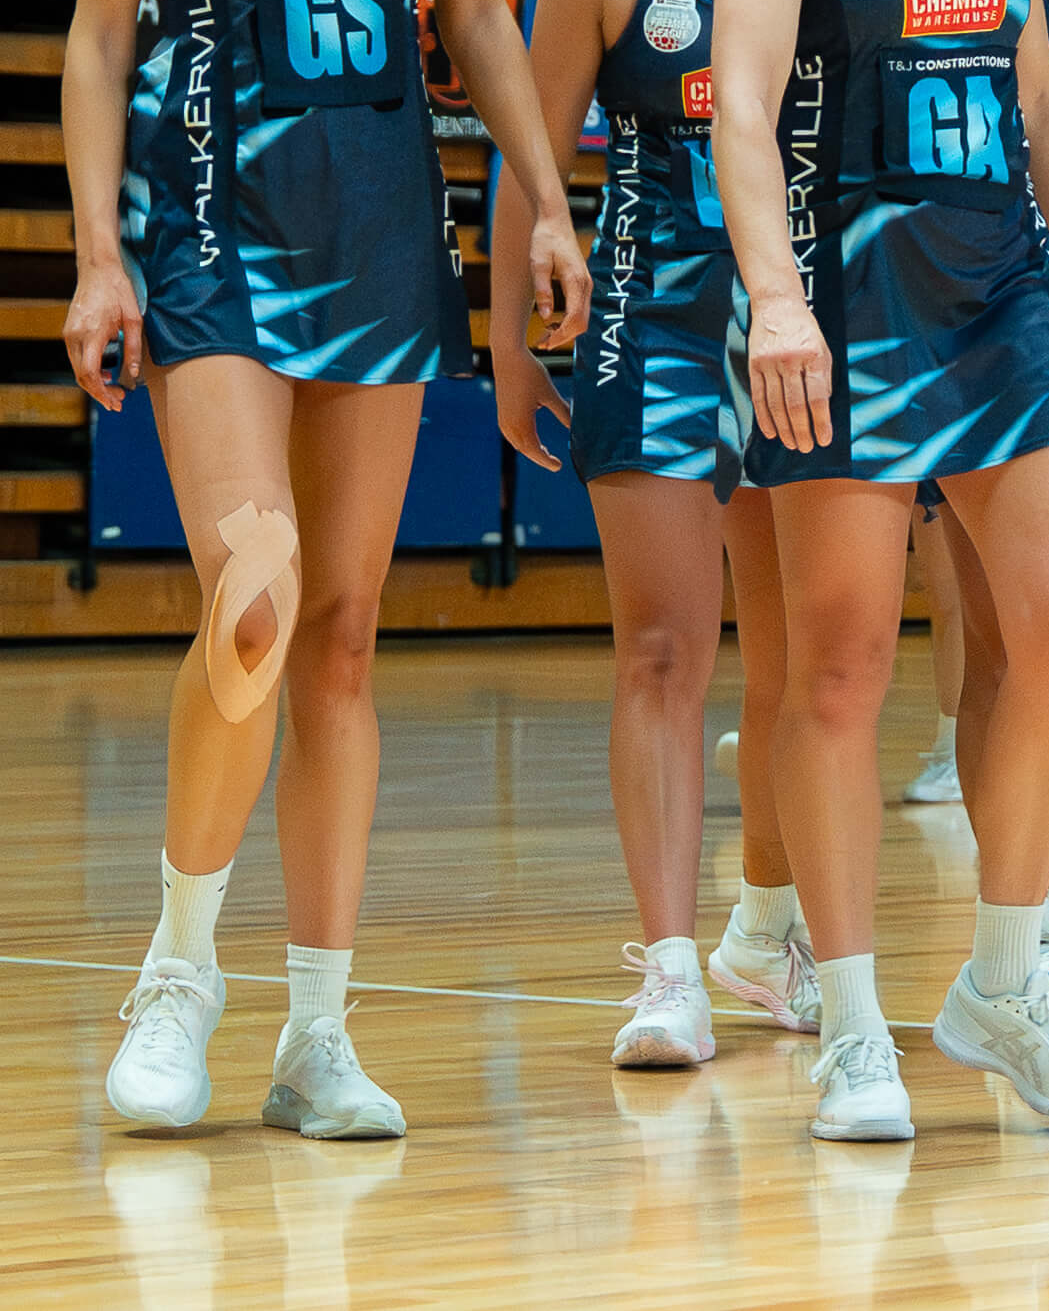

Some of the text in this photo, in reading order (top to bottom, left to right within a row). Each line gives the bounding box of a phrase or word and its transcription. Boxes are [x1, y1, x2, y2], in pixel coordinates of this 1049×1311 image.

[887, 55, 1011, 72] T&J CONSTRUCTIONS
[912, 10, 998, 28] WAREHOUSE
[788, 55, 824, 310] LKERVILLE
[908, 75, 1009, 185] GA
[597, 114, 640, 387] WALKERVILLE
